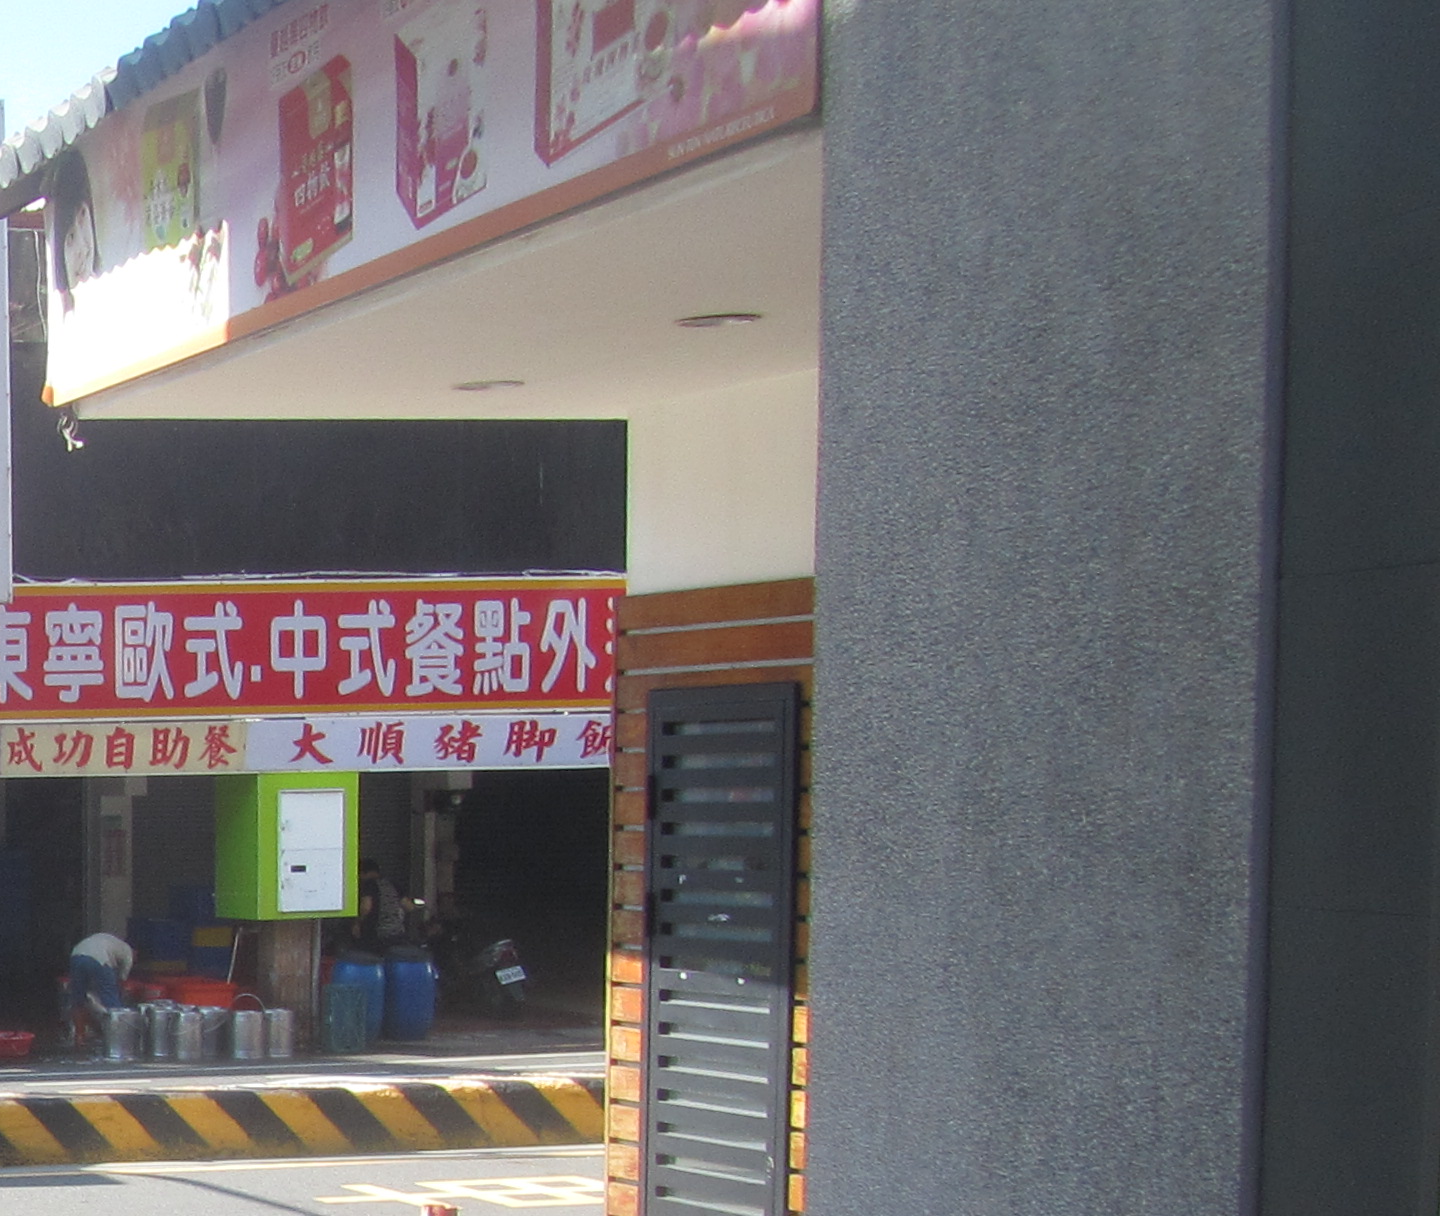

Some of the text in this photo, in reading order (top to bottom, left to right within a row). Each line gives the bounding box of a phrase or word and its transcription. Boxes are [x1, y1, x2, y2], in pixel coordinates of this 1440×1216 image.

[7, 726, 239, 770] 成功自助餐
